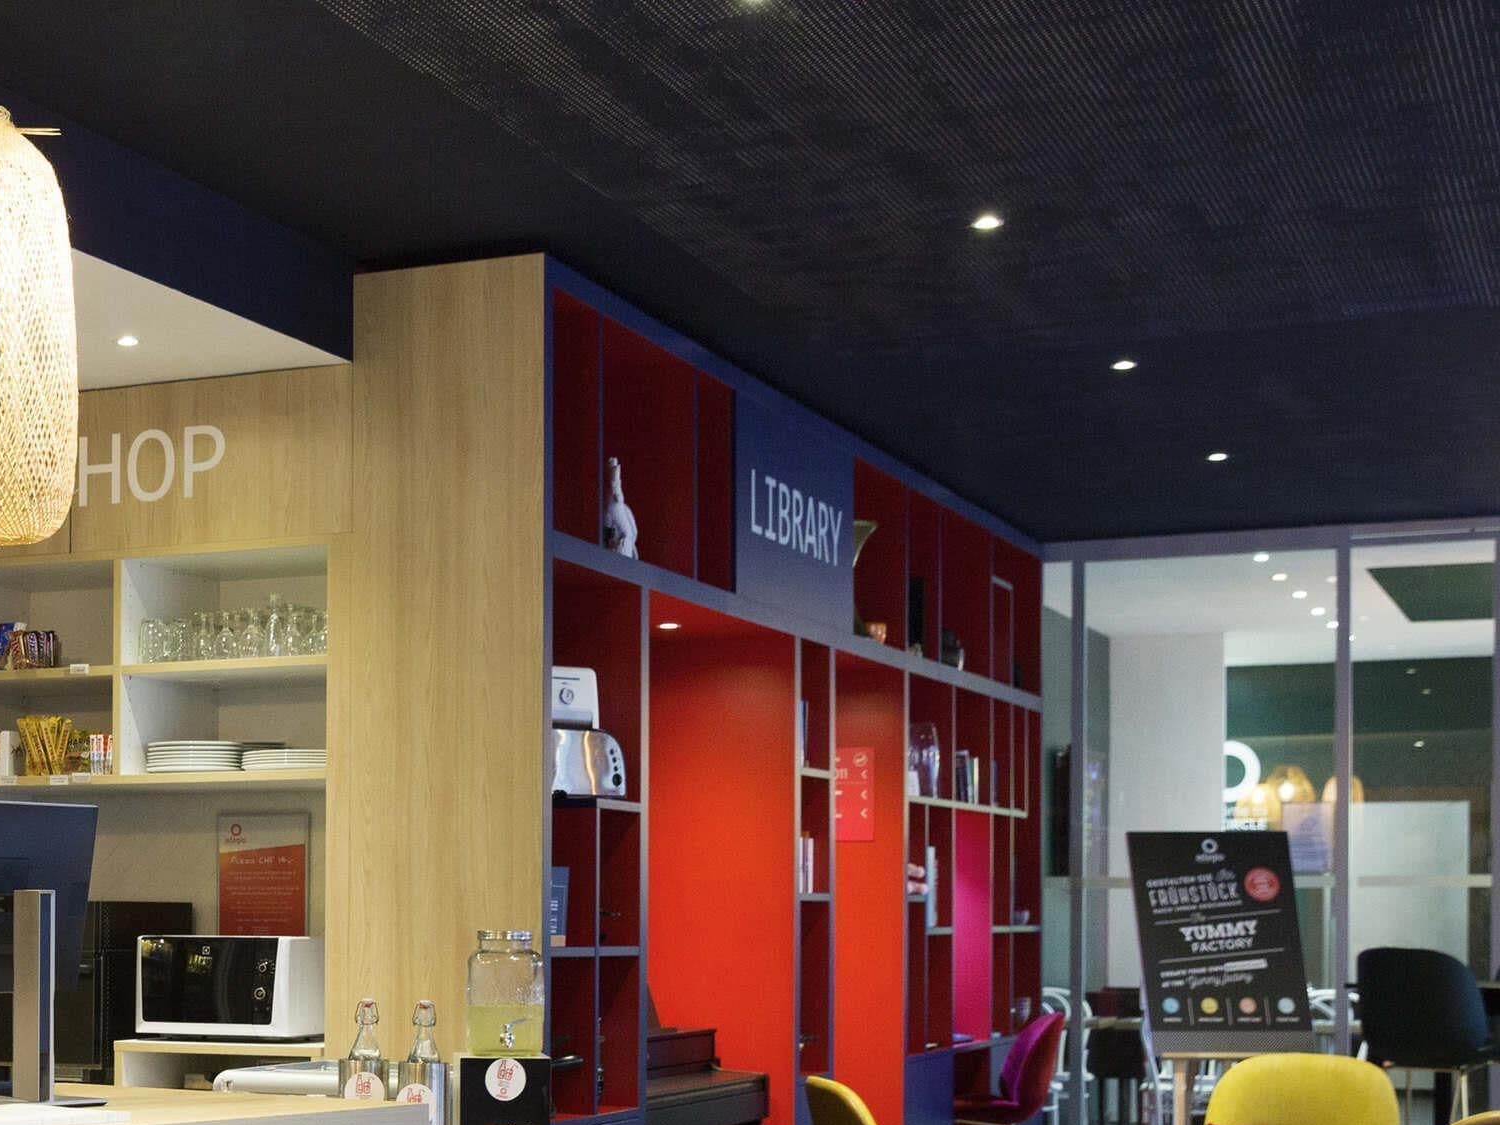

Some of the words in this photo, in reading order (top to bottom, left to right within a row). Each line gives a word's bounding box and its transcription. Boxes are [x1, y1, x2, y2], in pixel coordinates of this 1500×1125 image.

[78, 424, 226, 508] HOP
[750, 468, 843, 567] LIBRARY
[1148, 881, 1239, 908] FRÜHSTÜCK
[1179, 919, 1258, 942] YUMMY
[1190, 937, 1254, 953] FACTORY
